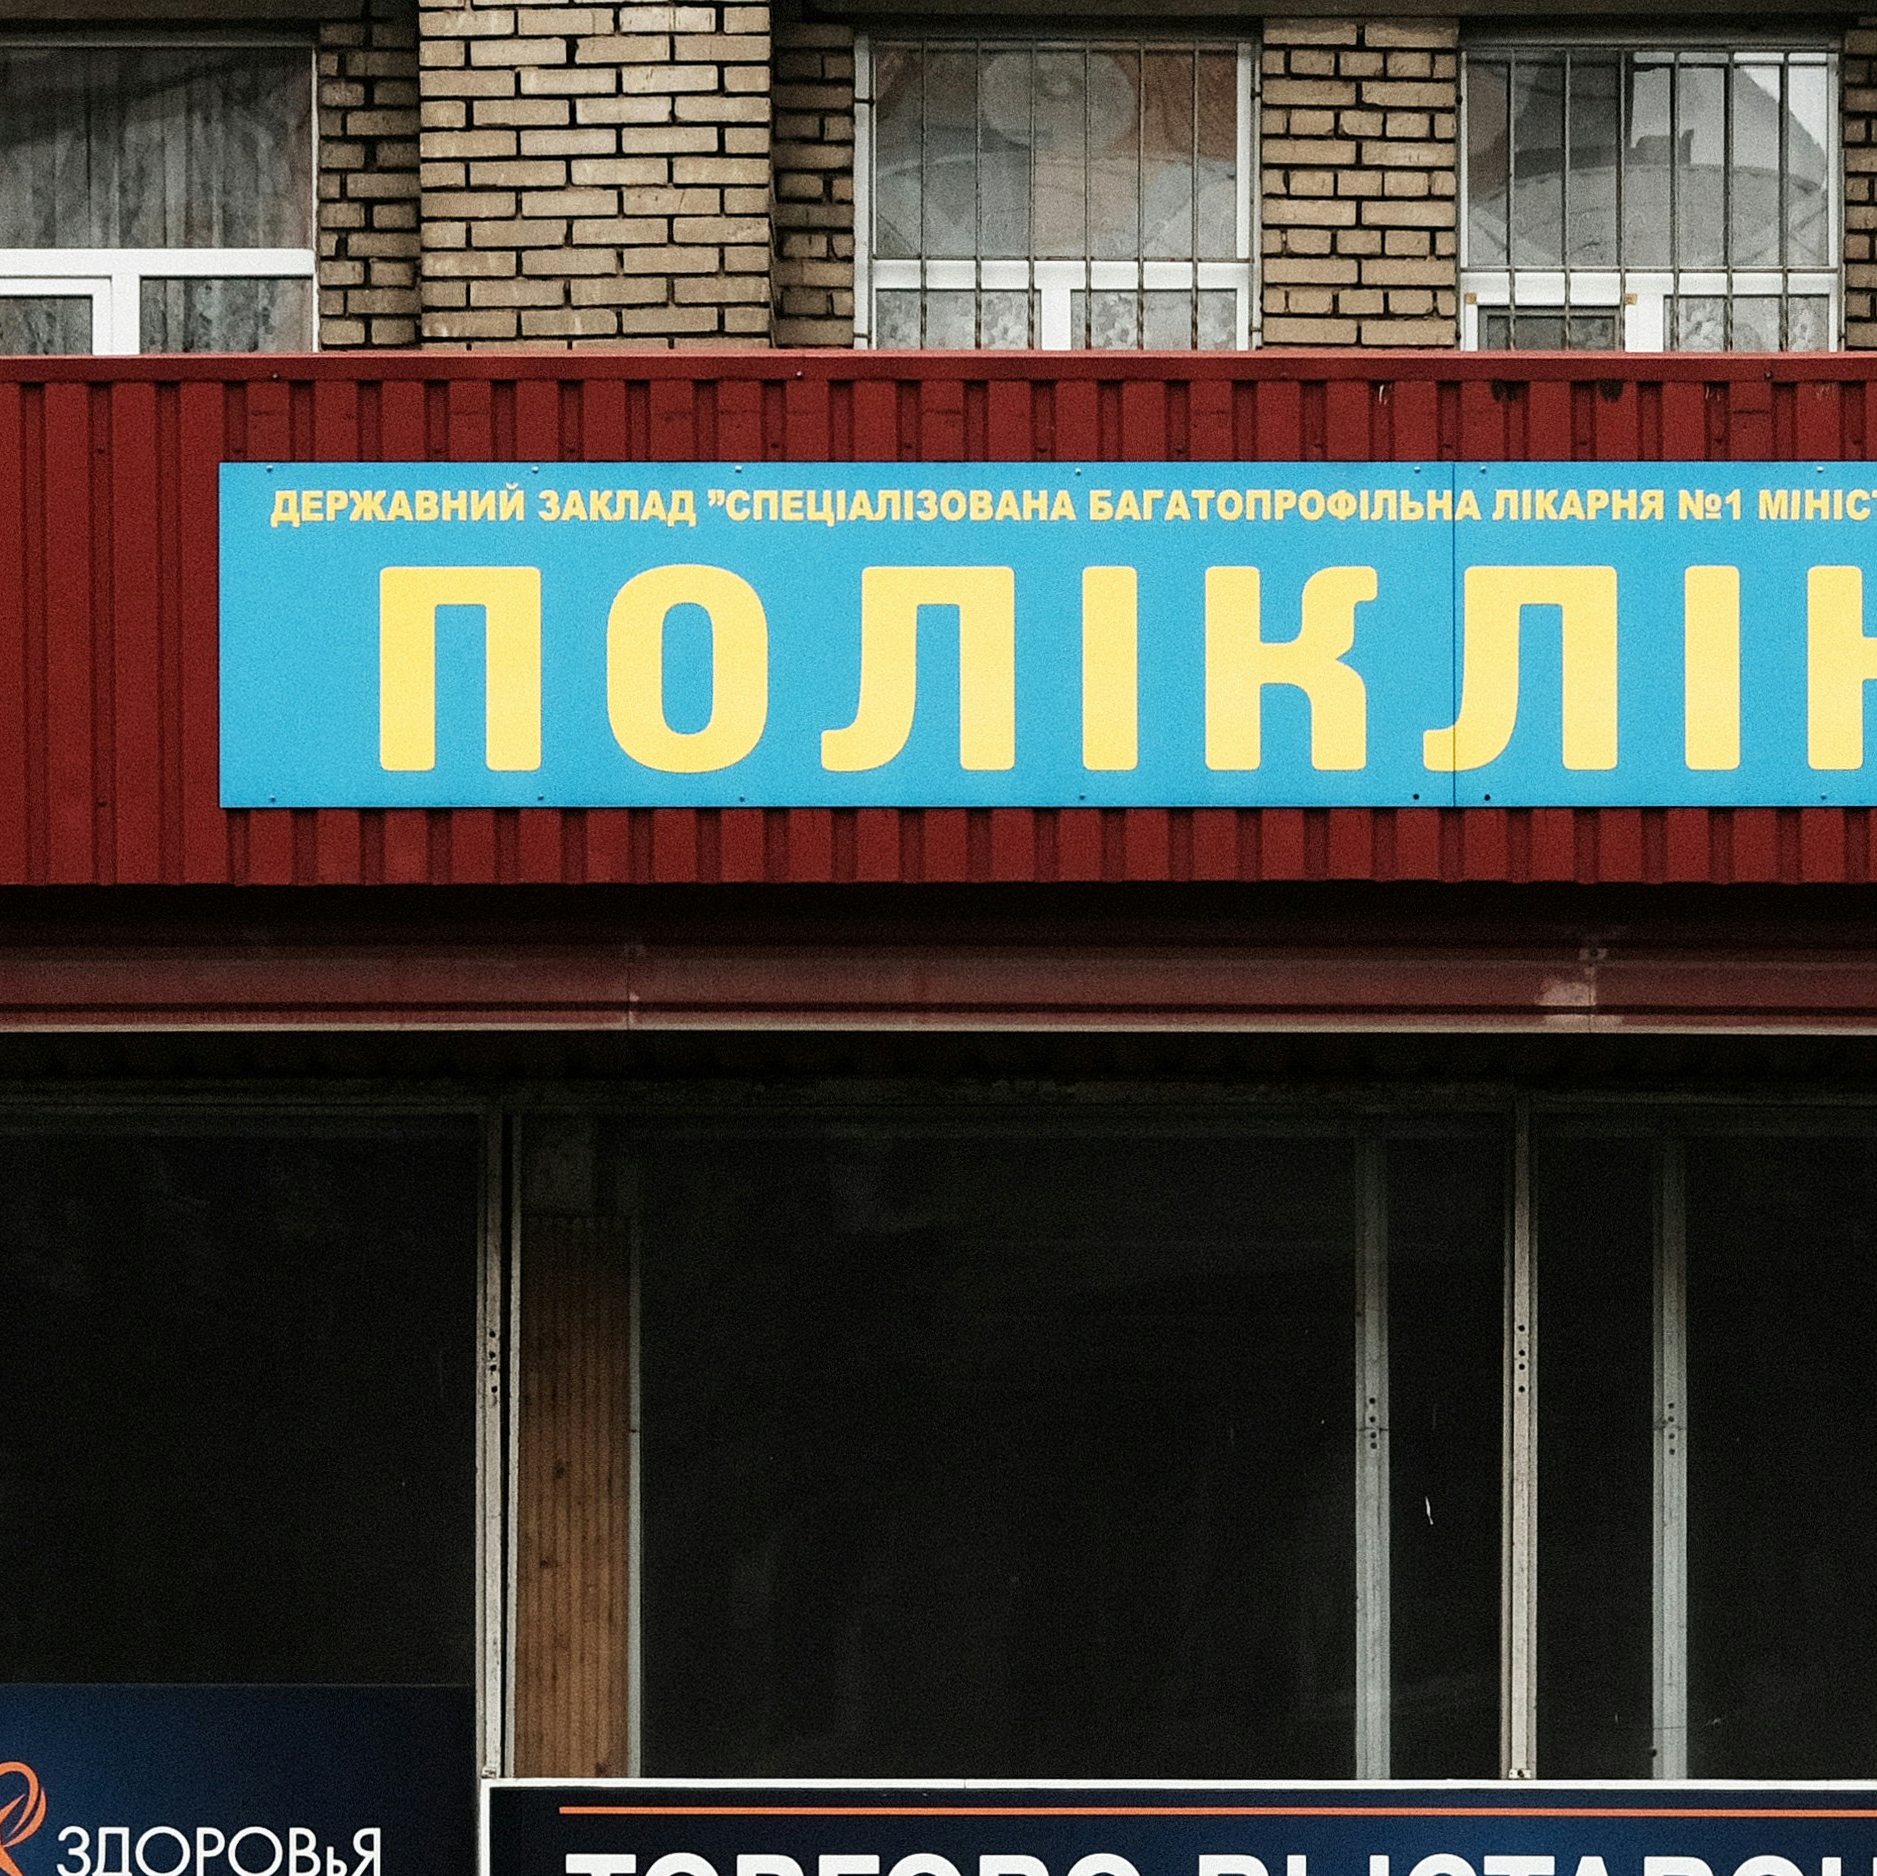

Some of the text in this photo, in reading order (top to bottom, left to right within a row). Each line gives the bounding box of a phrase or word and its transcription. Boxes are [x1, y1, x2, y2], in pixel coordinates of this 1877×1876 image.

[270, 482, 525, 527] ДЕРЖАВНИЙ
[539, 489, 697, 527] ЗАКЛАД
[1089, 488, 1482, 522] БАГАТОПРОФІЛЬНА
[1492, 488, 1665, 521] ЛІКАРНЯ
[1678, 488, 1742, 520] №1
